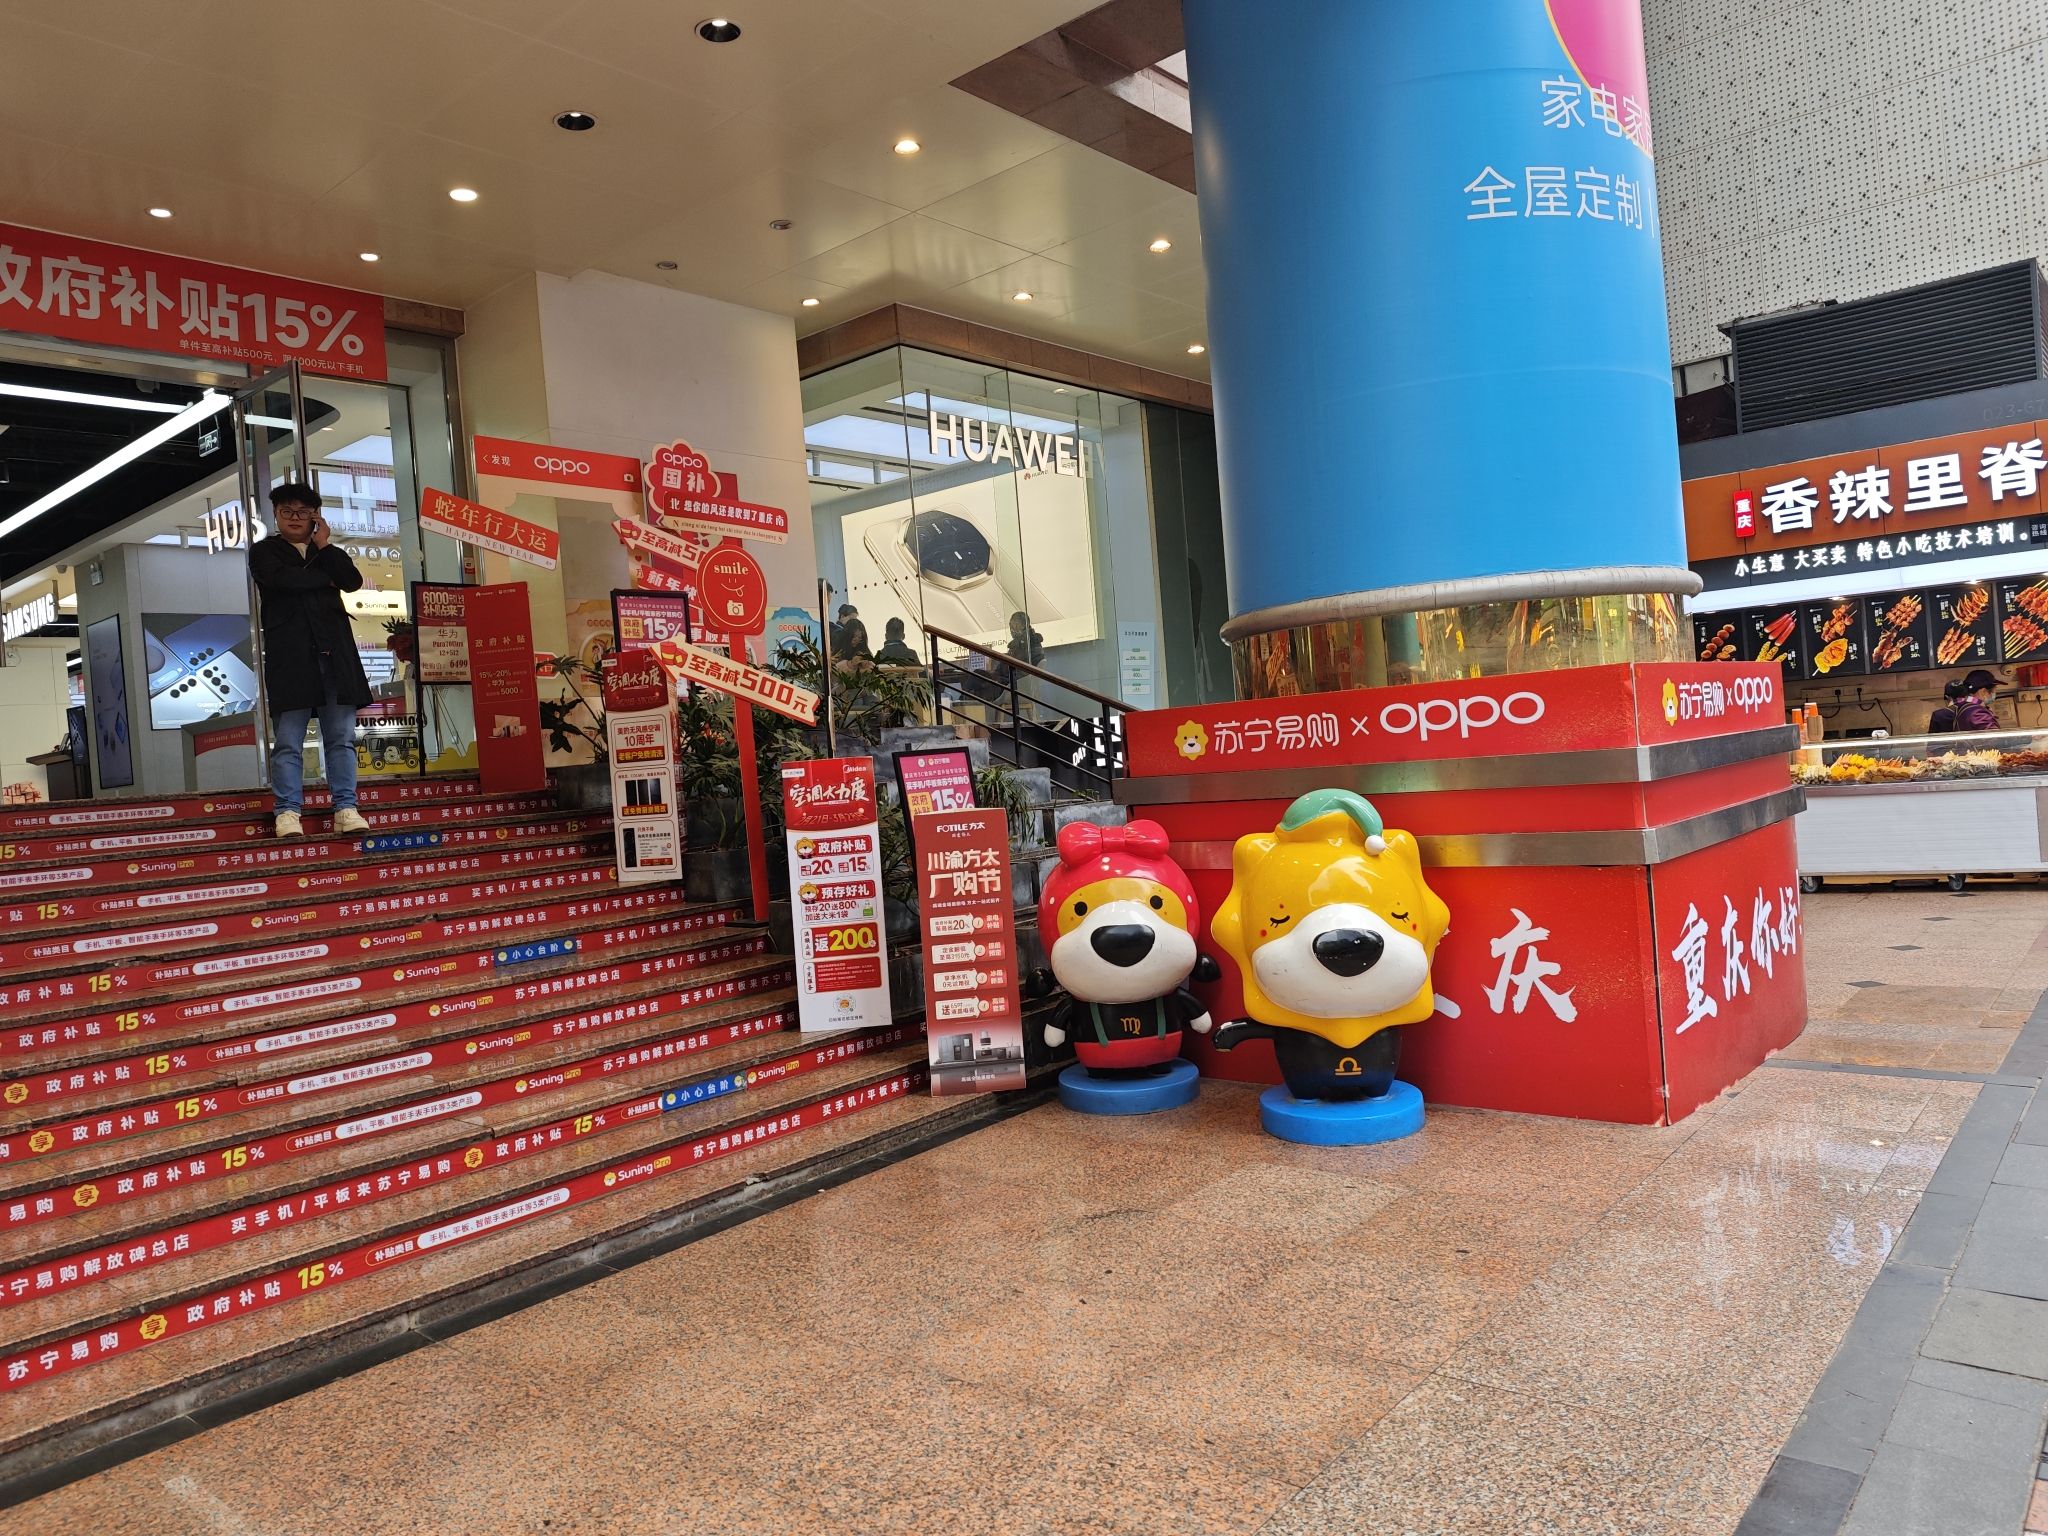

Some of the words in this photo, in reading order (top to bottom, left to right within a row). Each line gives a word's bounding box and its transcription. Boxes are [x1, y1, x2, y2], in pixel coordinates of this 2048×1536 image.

[1541, 75, 1652, 152] 家电家
[1463, 165, 1643, 230] 全屋定制
[491, 453, 511, 467] 发现
[662, 452, 703, 468] oppo
[929, 411, 1086, 478] HUAWEI
[534, 454, 590, 476] oppo
[662, 466, 706, 493] 国补
[1761, 438, 2048, 534] 香辣里脊
[434, 495, 547, 552] 蛇年行大运
[670, 498, 680, 510] 北
[775, 515, 784, 527] 南
[1735, 497, 1753, 529] 重庆
[445, 526, 480, 543] HAPPY
[484, 539, 507, 552] NEW
[509, 546, 535, 561] YEAR
[641, 529, 706, 564] 至高减5
[713, 561, 749, 575] smile
[1734, 552, 1785, 578] 小生意
[1793, 544, 1848, 570] 大买卖
[474, 634, 526, 648] 政府补贴
[643, 617, 682, 640] 15%
[607, 665, 663, 692] 空调大力度
[688, 653, 808, 714] 至高减500元
[1677, 681, 1726, 720] 苏宁易购
[1734, 675, 1774, 715] oppo
[1213, 711, 1340, 755] 苏宁易购
[1379, 691, 1546, 742] oppo
[624, 733, 655, 747] 10周年
[843, 764, 867, 774] Midea
[14, 818, 46, 827] 补贴类目
[215, 802, 246, 812] Suning
[359, 791, 379, 801] 总店
[400, 784, 475, 797] 买手机/平板来
[789, 776, 870, 808] 空调大力度
[911, 795, 929, 806] 政府
[931, 788, 975, 812] 15%
[936, 823, 968, 833] FOTILE
[969, 822, 986, 830] 方太
[55, 841, 87, 853] 补贴类目
[141, 861, 176, 873] Suning
[217, 845, 329, 867] 苏宁易购解放碑总店
[379, 835, 425, 848] 小心台阶
[441, 830, 488, 844] 苏宁易购
[515, 824, 559, 836] 政府补贴
[818, 839, 867, 853] 政府补贴
[927, 848, 1001, 872] 川渝方太
[37, 903, 75, 920] 15%
[100, 899, 134, 911] 补贴类目
[310, 875, 342, 887] Suning
[378, 858, 480, 879] 苏宁易购解放碑总店
[821, 883, 870, 899] 预存好礼
[928, 867, 1001, 899] 厂购节
[33, 944, 69, 957] 补贴类目
[265, 912, 299, 925] Suning
[339, 893, 449, 916] 苏宁易购解放碑总店
[471, 872, 601, 898] 买手机/平板来苏宁易购
[805, 910, 849, 922] 加送大米1袋
[88, 973, 128, 993] 15%
[154, 966, 190, 980] 补贴类目
[372, 933, 405, 947] Suning
[442, 910, 548, 936] 苏宁易购解放碑总店
[18, 1022, 101, 1048] 政府补贴
[115, 1012, 156, 1032] 15%
[183, 1003, 220, 1017] 补贴类目
[406, 965, 440, 979] Suning
[511, 943, 559, 960] 小心台阶
[604, 913, 726, 944] 买手机/平板来苏宁易购
[46, 1066, 130, 1094] 政府补贴
[145, 1054, 187, 1076] 15%
[215, 1044, 251, 1059] 补贴类目
[442, 998, 476, 1014] Suning
[515, 970, 620, 999] 苏宁易购解放碑总店
[642, 941, 765, 973] 买手机/平板来苏宁易购
[72, 1110, 159, 1141] 政府补贴
[175, 1098, 218, 1120] 15%
[246, 1085, 284, 1101] 补贴类目
[479, 1035, 514, 1051] Suning
[552, 1001, 659, 1035] 苏宁易购解放碑总店
[9, 1198, 53, 1222] 易购
[117, 1161, 206, 1194] 政府补贴
[221, 1146, 266, 1169] 15%
[294, 1131, 332, 1149] 补贴类目
[528, 1072, 563, 1089] Suning
[603, 1034, 709, 1071] 苏宁易购解放碑总店
[0, 1234, 189, 1299] 宁易购解放碑总店
[231, 1158, 450, 1235] 买手机/平板来苏宁易购
[496, 1127, 562, 1157] 政府补贴
[574, 1114, 606, 1136] 15%
[627, 1101, 656, 1117] 补贴类目
[681, 1080, 729, 1102] 小心台阶
[757, 1065, 786, 1081] Suning
[816, 1029, 903, 1063] 苏宁易购解放碑总店
[8, 1331, 119, 1382] 苏宁易购
[187, 1280, 281, 1323] 政府补贴
[297, 1261, 345, 1289] 15%
[374, 1241, 414, 1262] 补贴类目
[617, 1161, 654, 1182] Suning
[693, 1114, 801, 1159] 苏宁易购解放碑总店
